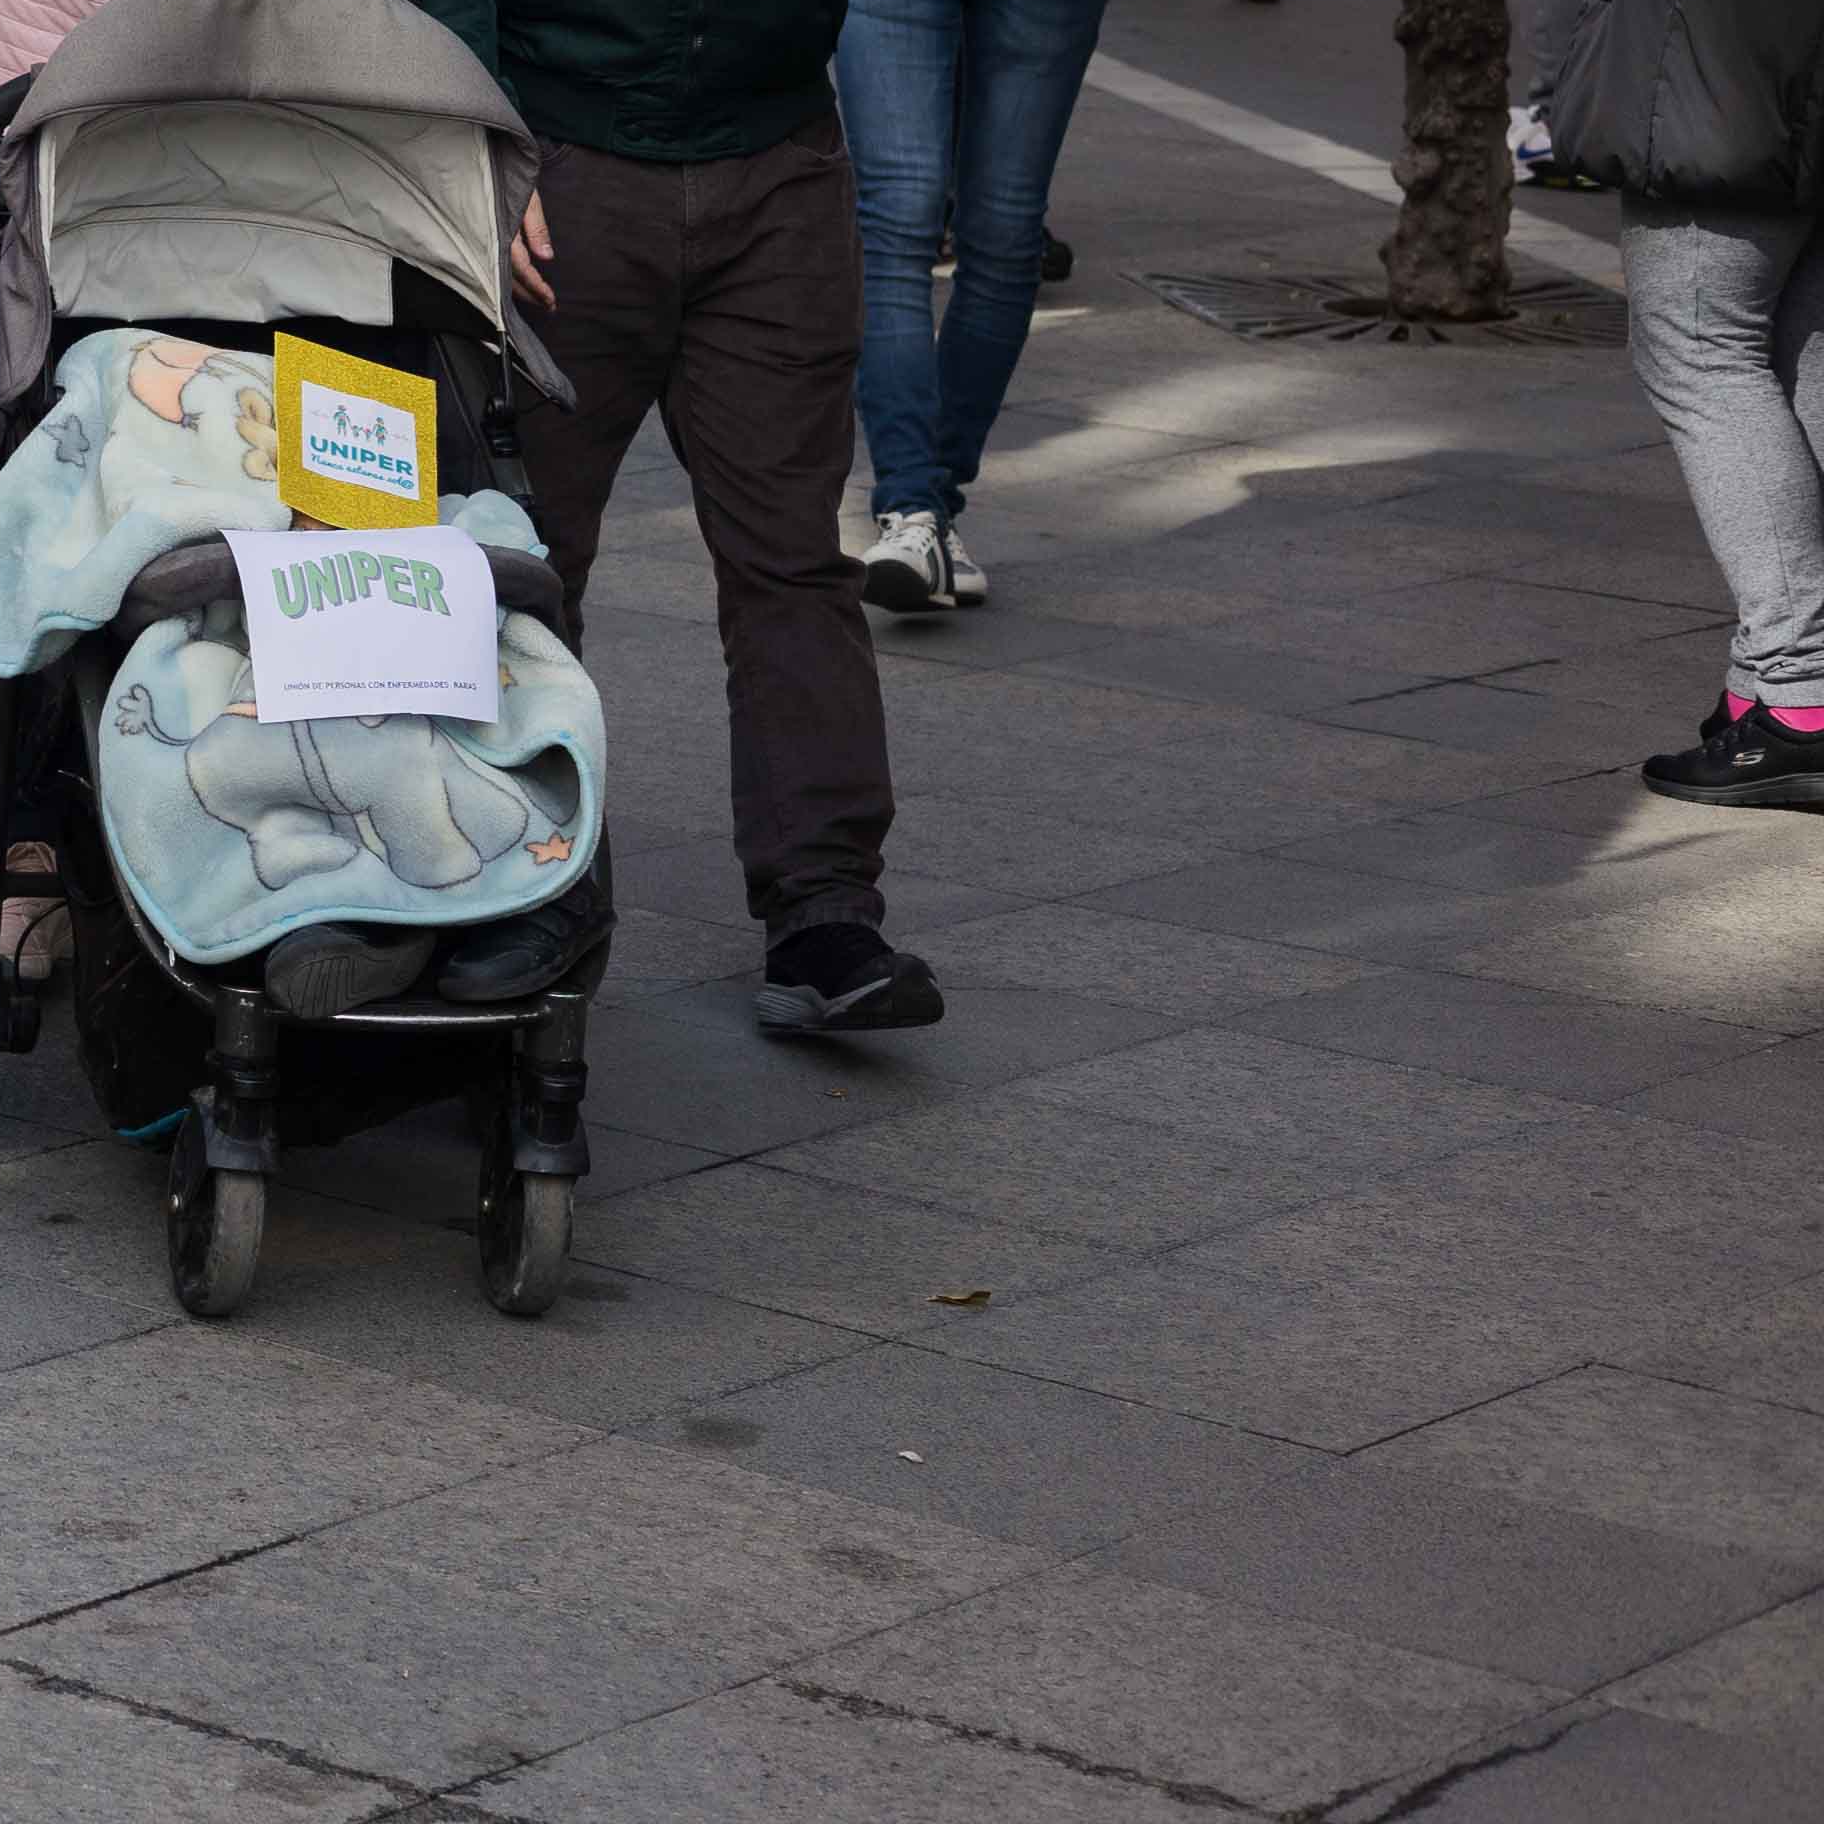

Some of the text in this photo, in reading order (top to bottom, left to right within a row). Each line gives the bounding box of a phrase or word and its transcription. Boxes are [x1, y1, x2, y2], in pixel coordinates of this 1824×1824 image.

[309, 434, 414, 476] UNIPER
[271, 549, 452, 620] UNIPER
[312, 680, 323, 690] DE
[325, 680, 366, 690] PERSONAS
[368, 680, 385, 689] CON
[387, 679, 449, 690] ENFERMEDADES
[453, 680, 477, 691] RARAS
